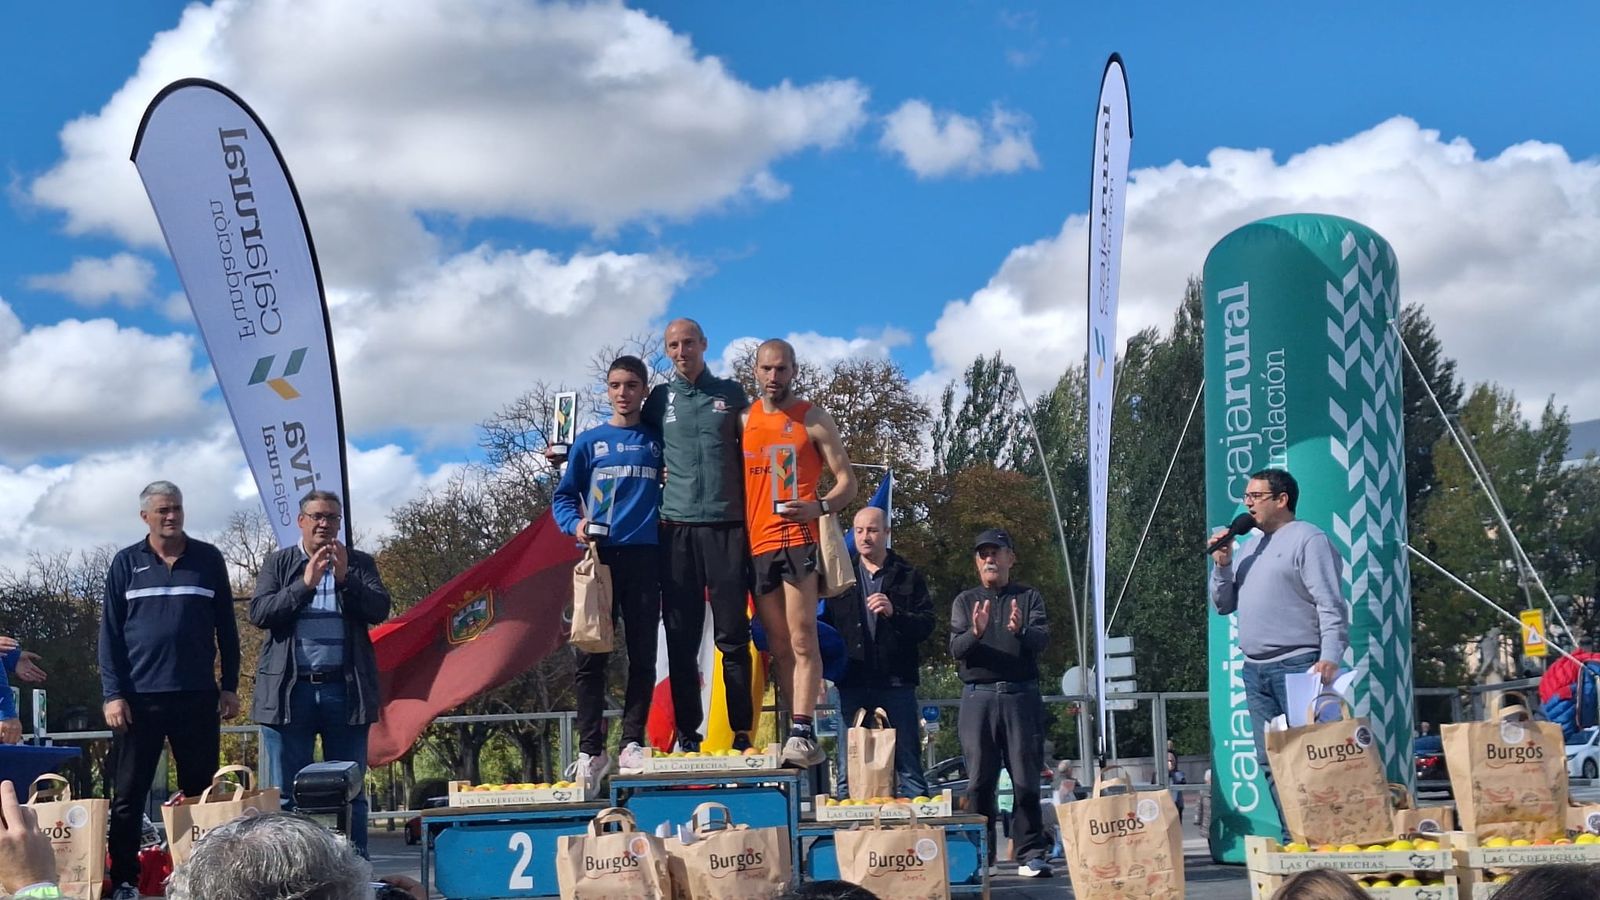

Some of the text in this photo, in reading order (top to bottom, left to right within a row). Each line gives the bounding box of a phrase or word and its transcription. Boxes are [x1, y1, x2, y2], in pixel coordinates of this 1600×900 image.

[1217, 281, 1262, 504] cajarural
[1306, 743, 1364, 763] Burgos
[1486, 743, 1543, 764] Burgos
[845, 809, 903, 819] CADERCHAS
[1089, 817, 1145, 837] Burgos
[508, 831, 534, 890] 2
[586, 855, 639, 873] Burgos
[709, 852, 763, 872] Burgos
[869, 851, 924, 872] Burgos
[1280, 858, 1386, 870] LAS CADERECHAS
